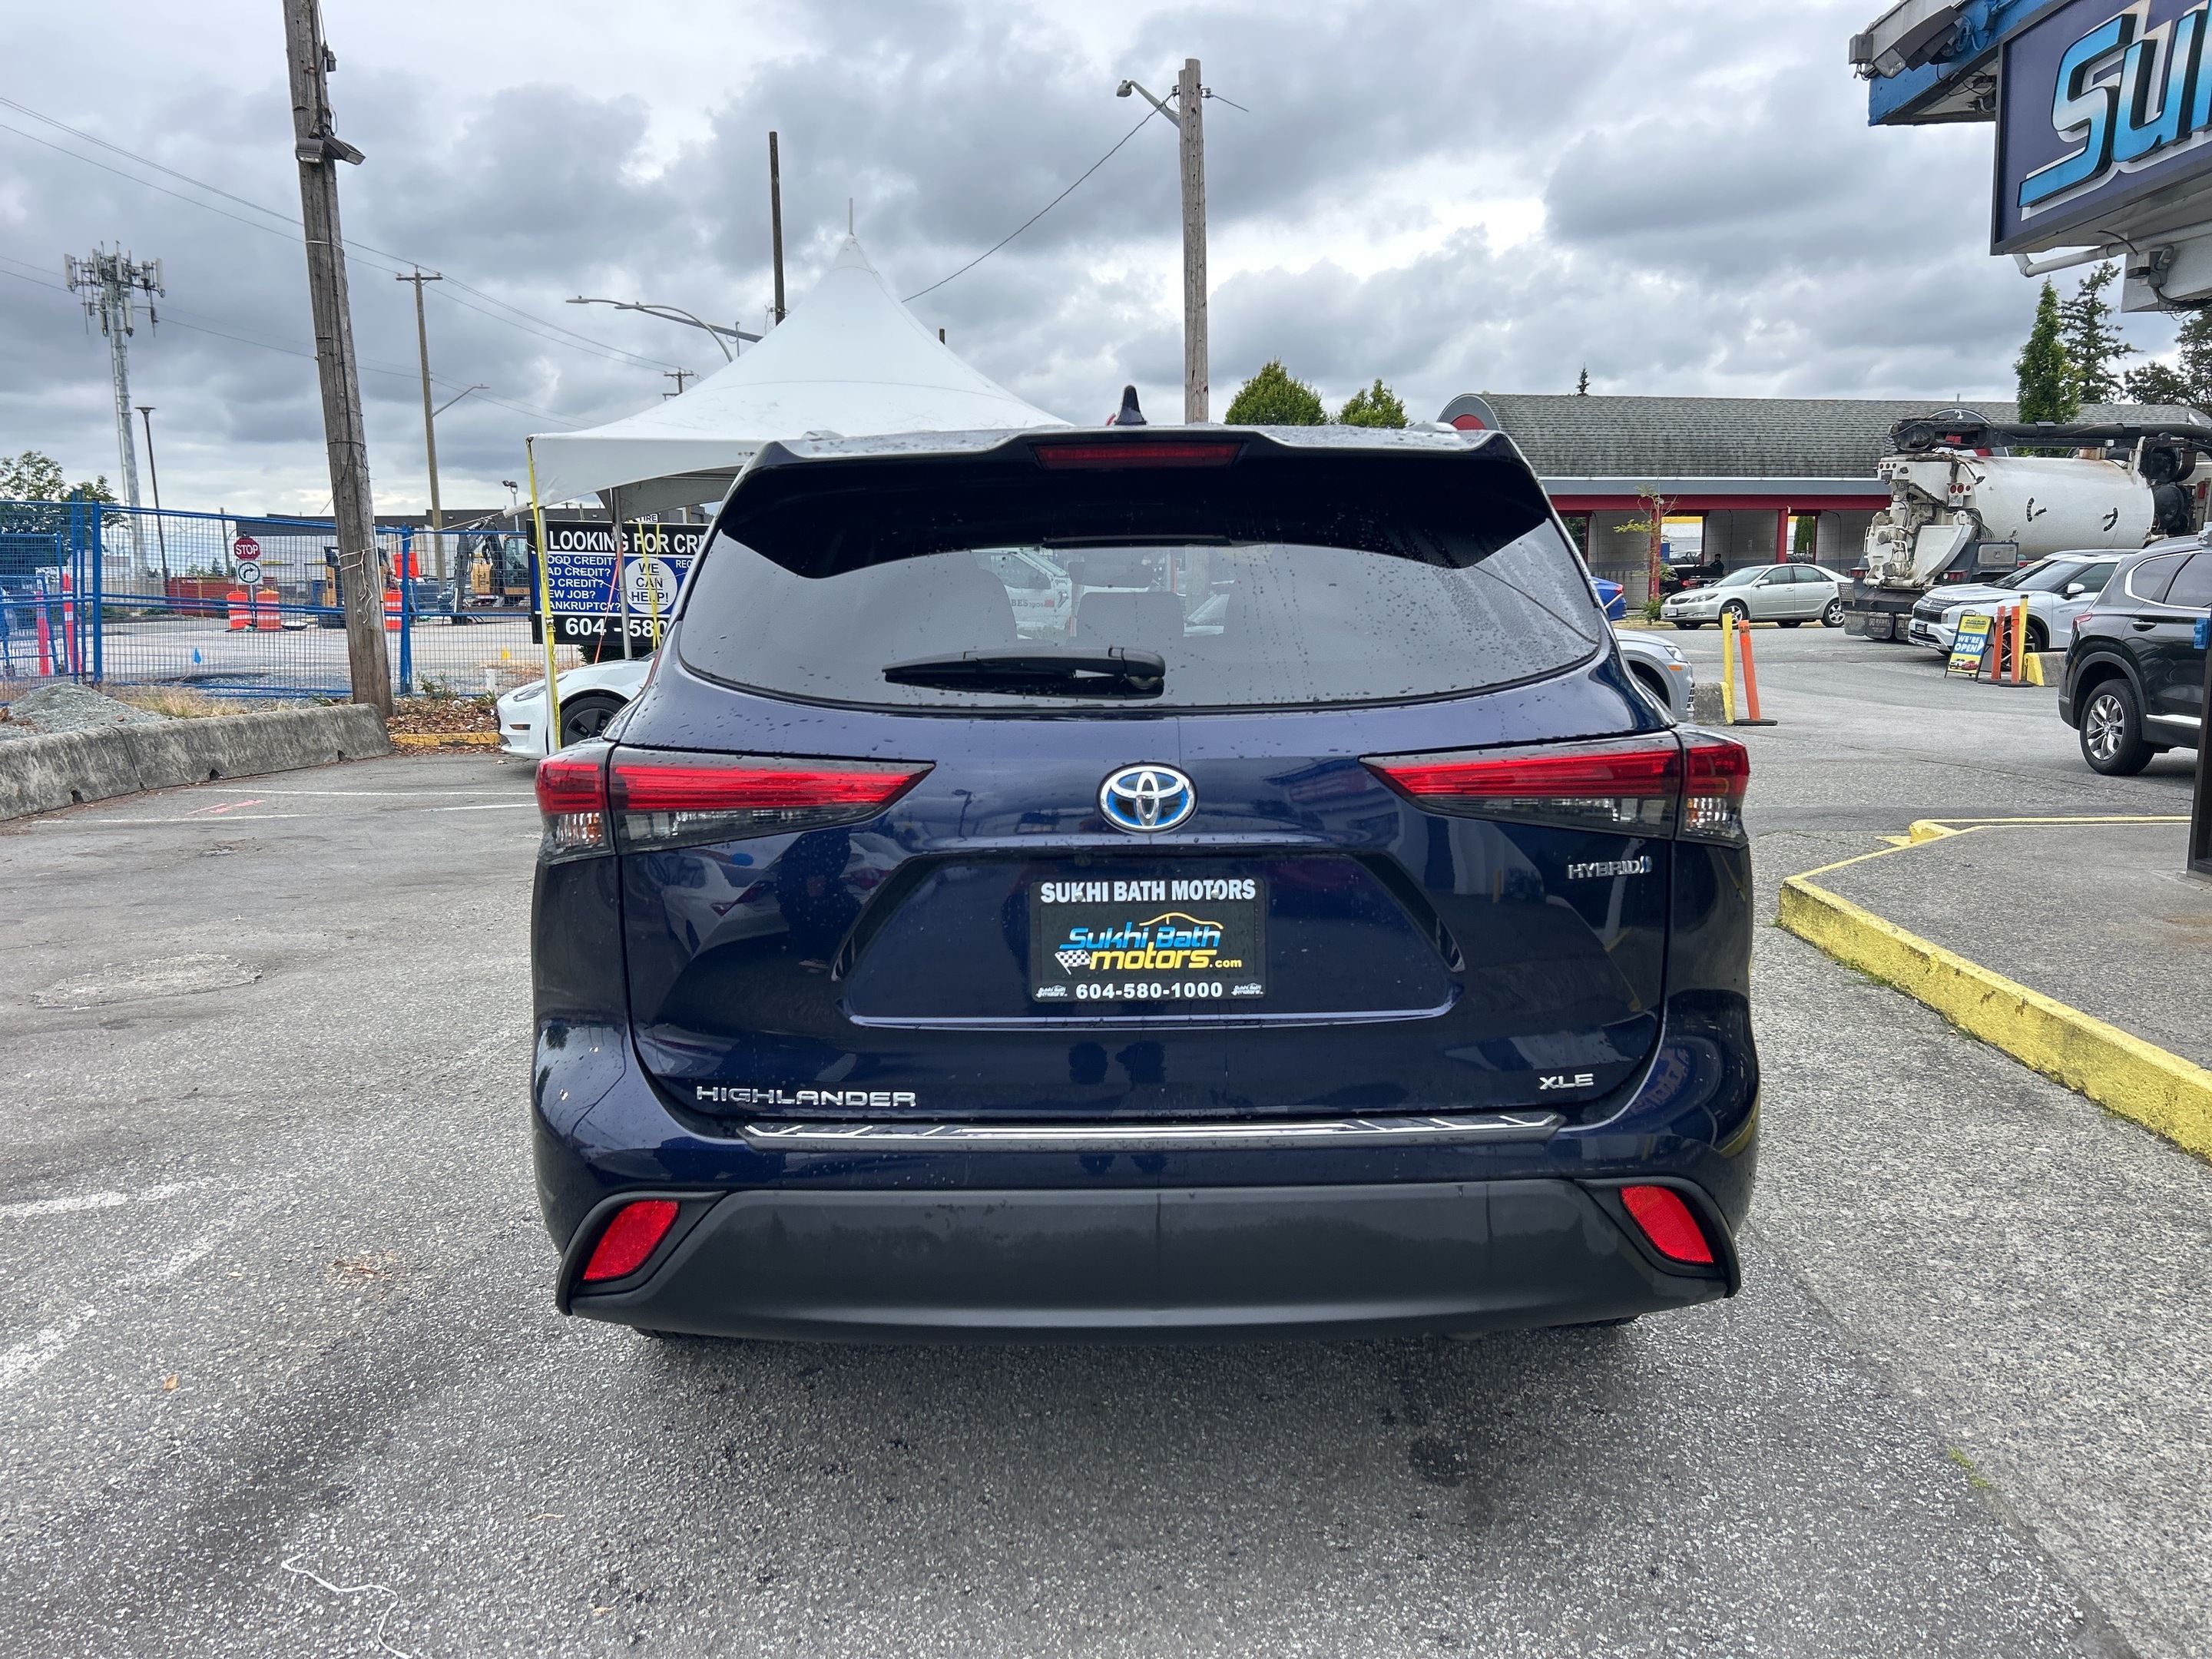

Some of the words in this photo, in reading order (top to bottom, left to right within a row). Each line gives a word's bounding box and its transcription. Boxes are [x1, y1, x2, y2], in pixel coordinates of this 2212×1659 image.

[549, 531, 629, 552] LOOKING
[634, 533, 670, 553] FOR
[235, 544, 259, 555] STOP
[548, 556, 571, 565] OOD
[548, 567, 561, 575] AD
[565, 568, 611, 577] CREDIT?
[638, 563, 659, 574] WE
[558, 578, 604, 588] CREDIT?
[636, 578, 663, 588] CAN
[546, 590, 565, 598] EW
[567, 591, 595, 599] JOB?
[548, 601, 621, 611] ANKRUPTCY?
[565, 618, 607, 636] 604
[1958, 635, 1980, 644] WE'RE
[1954, 643, 1978, 653] OPEN
[1568, 859, 1641, 879] HYBRID
[1040, 882, 1108, 902] SUKHI
[1114, 880, 1165, 902] BATH
[1171, 879, 1256, 901] MOTORS
[1059, 922, 1149, 949] Sukhi
[1155, 926, 1221, 949] Bath
[1075, 982, 1223, 999] 604-580-1000
[1539, 1073, 1594, 1090] XLE
[696, 1085, 916, 1107] HIGHLANDER
